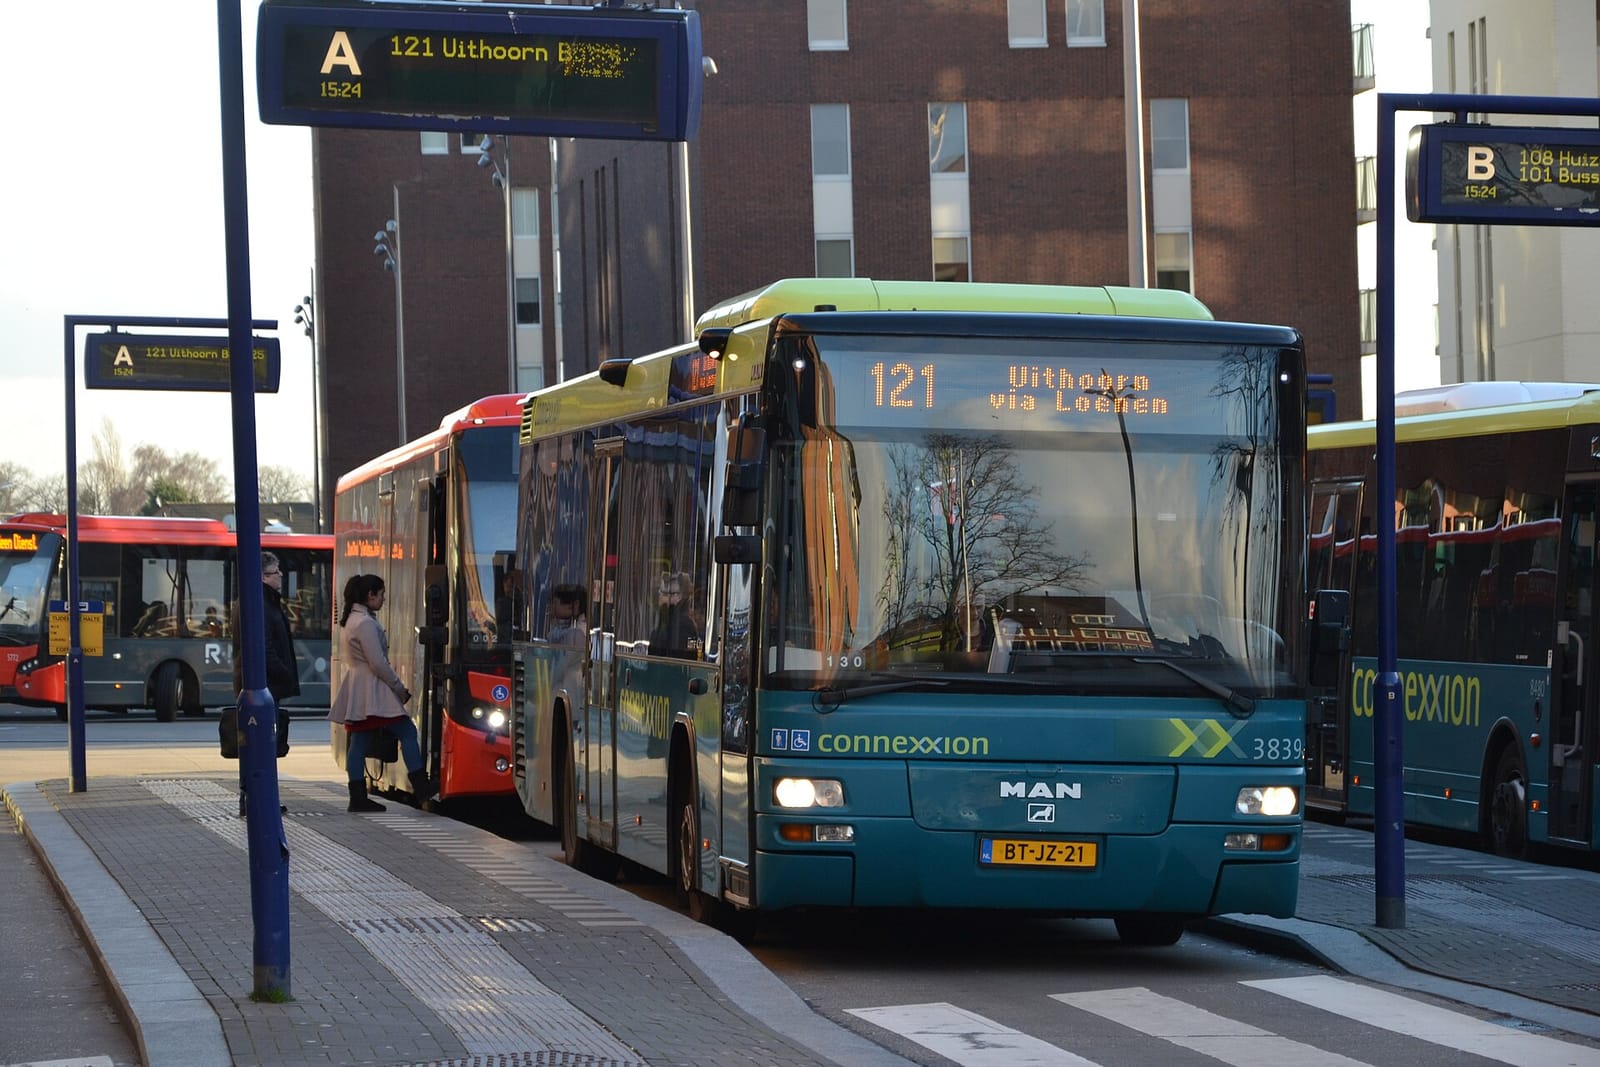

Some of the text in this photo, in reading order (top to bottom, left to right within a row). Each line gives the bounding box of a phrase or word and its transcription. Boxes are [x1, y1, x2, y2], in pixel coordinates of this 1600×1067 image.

[320, 31, 362, 76] A
[391, 36, 434, 57] 121
[443, 38, 548, 62] Uithoorn
[320, 81, 362, 98] 15:24
[1467, 147, 1495, 180] B
[1520, 151, 1553, 165] 108
[1520, 167, 1600, 184] 101 Buss
[1465, 186, 1497, 198] 15:24
[113, 345, 134, 366] A
[146, 347, 166, 358] 121
[169, 348, 218, 359] Uithoorn
[871, 361, 935, 408] 121
[1009, 365, 1149, 391] Uithoorn
[989, 389, 1168, 414] via Loenen
[1352, 668, 1480, 727] coexxion
[1387, 691, 1396, 700] B
[247, 716, 258, 726] A
[818, 733, 989, 755] connexxion
[1253, 738, 1302, 760] 3839
[1000, 781, 1081, 799] MAN
[1005, 843, 1083, 863] BT-JZ-21
